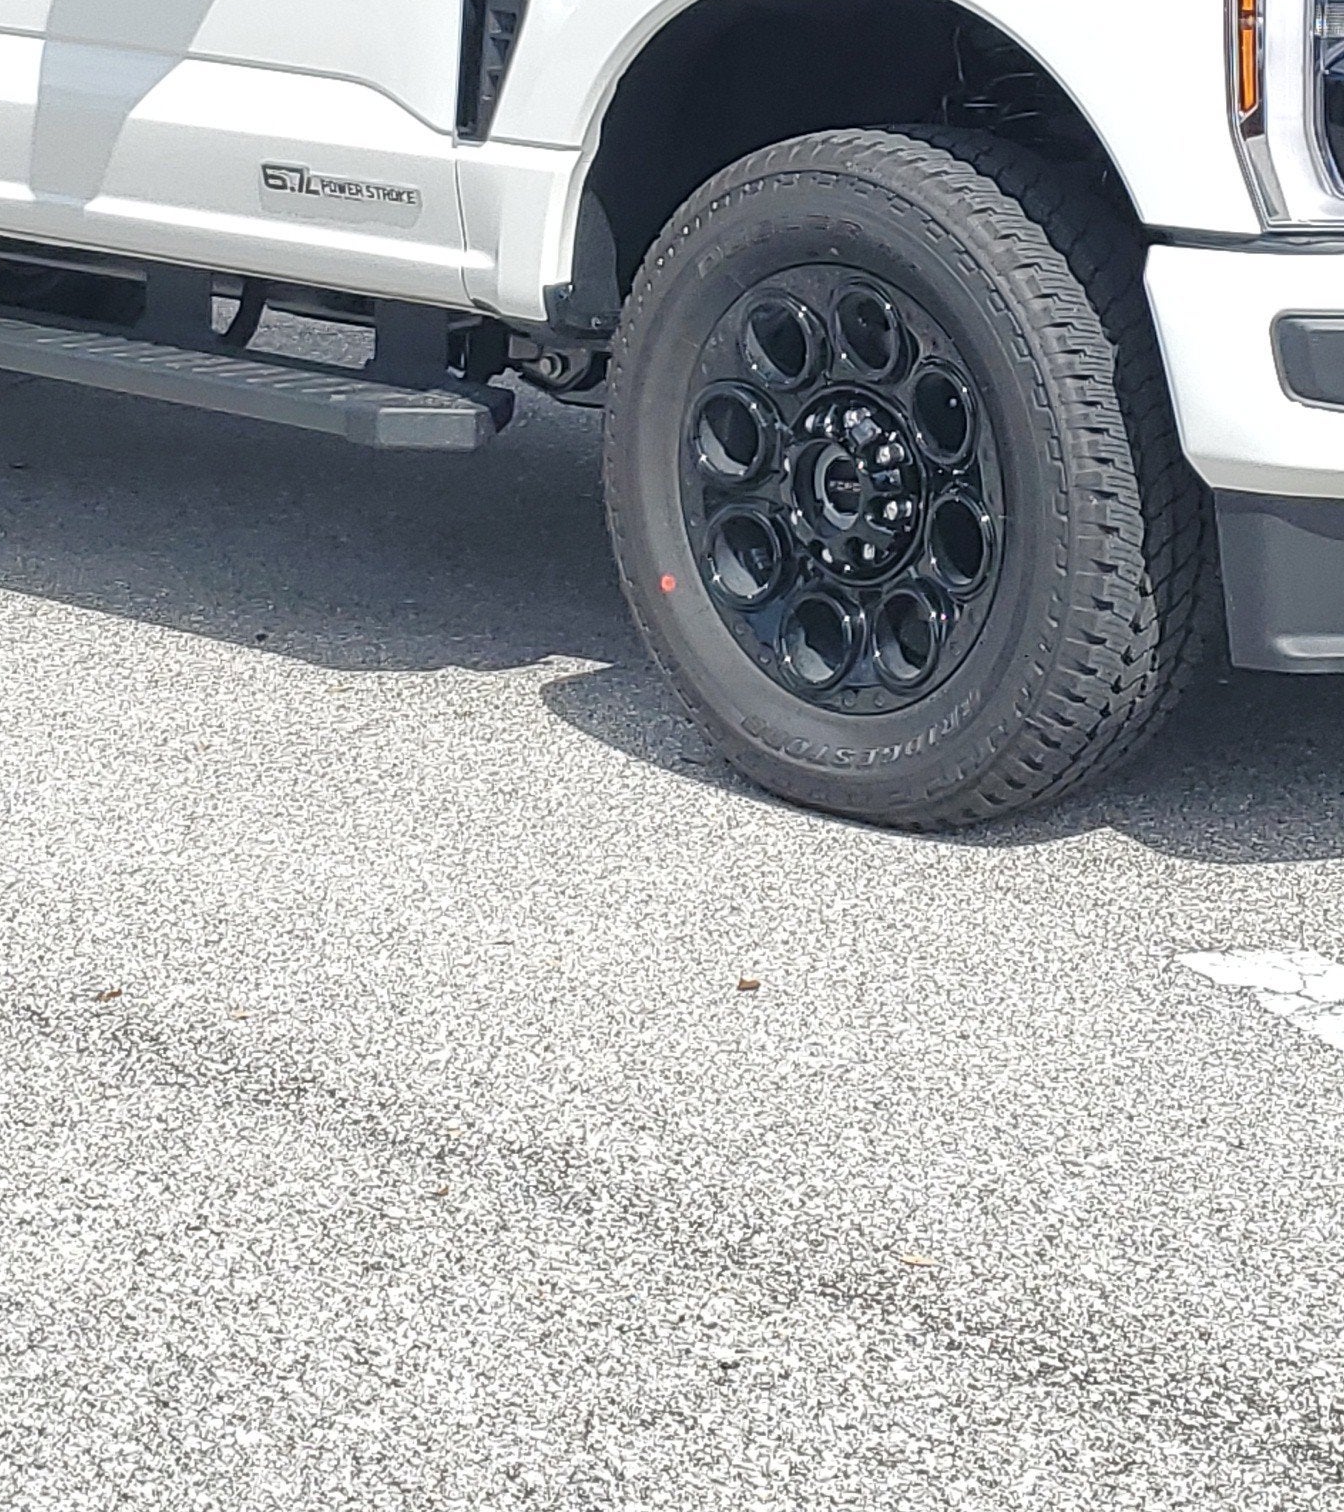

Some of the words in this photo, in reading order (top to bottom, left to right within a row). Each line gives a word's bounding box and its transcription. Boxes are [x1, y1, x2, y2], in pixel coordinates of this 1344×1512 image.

[261, 163, 320, 196] 6.7L
[321, 179, 365, 198] POWER
[366, 185, 417, 205] STROKE
